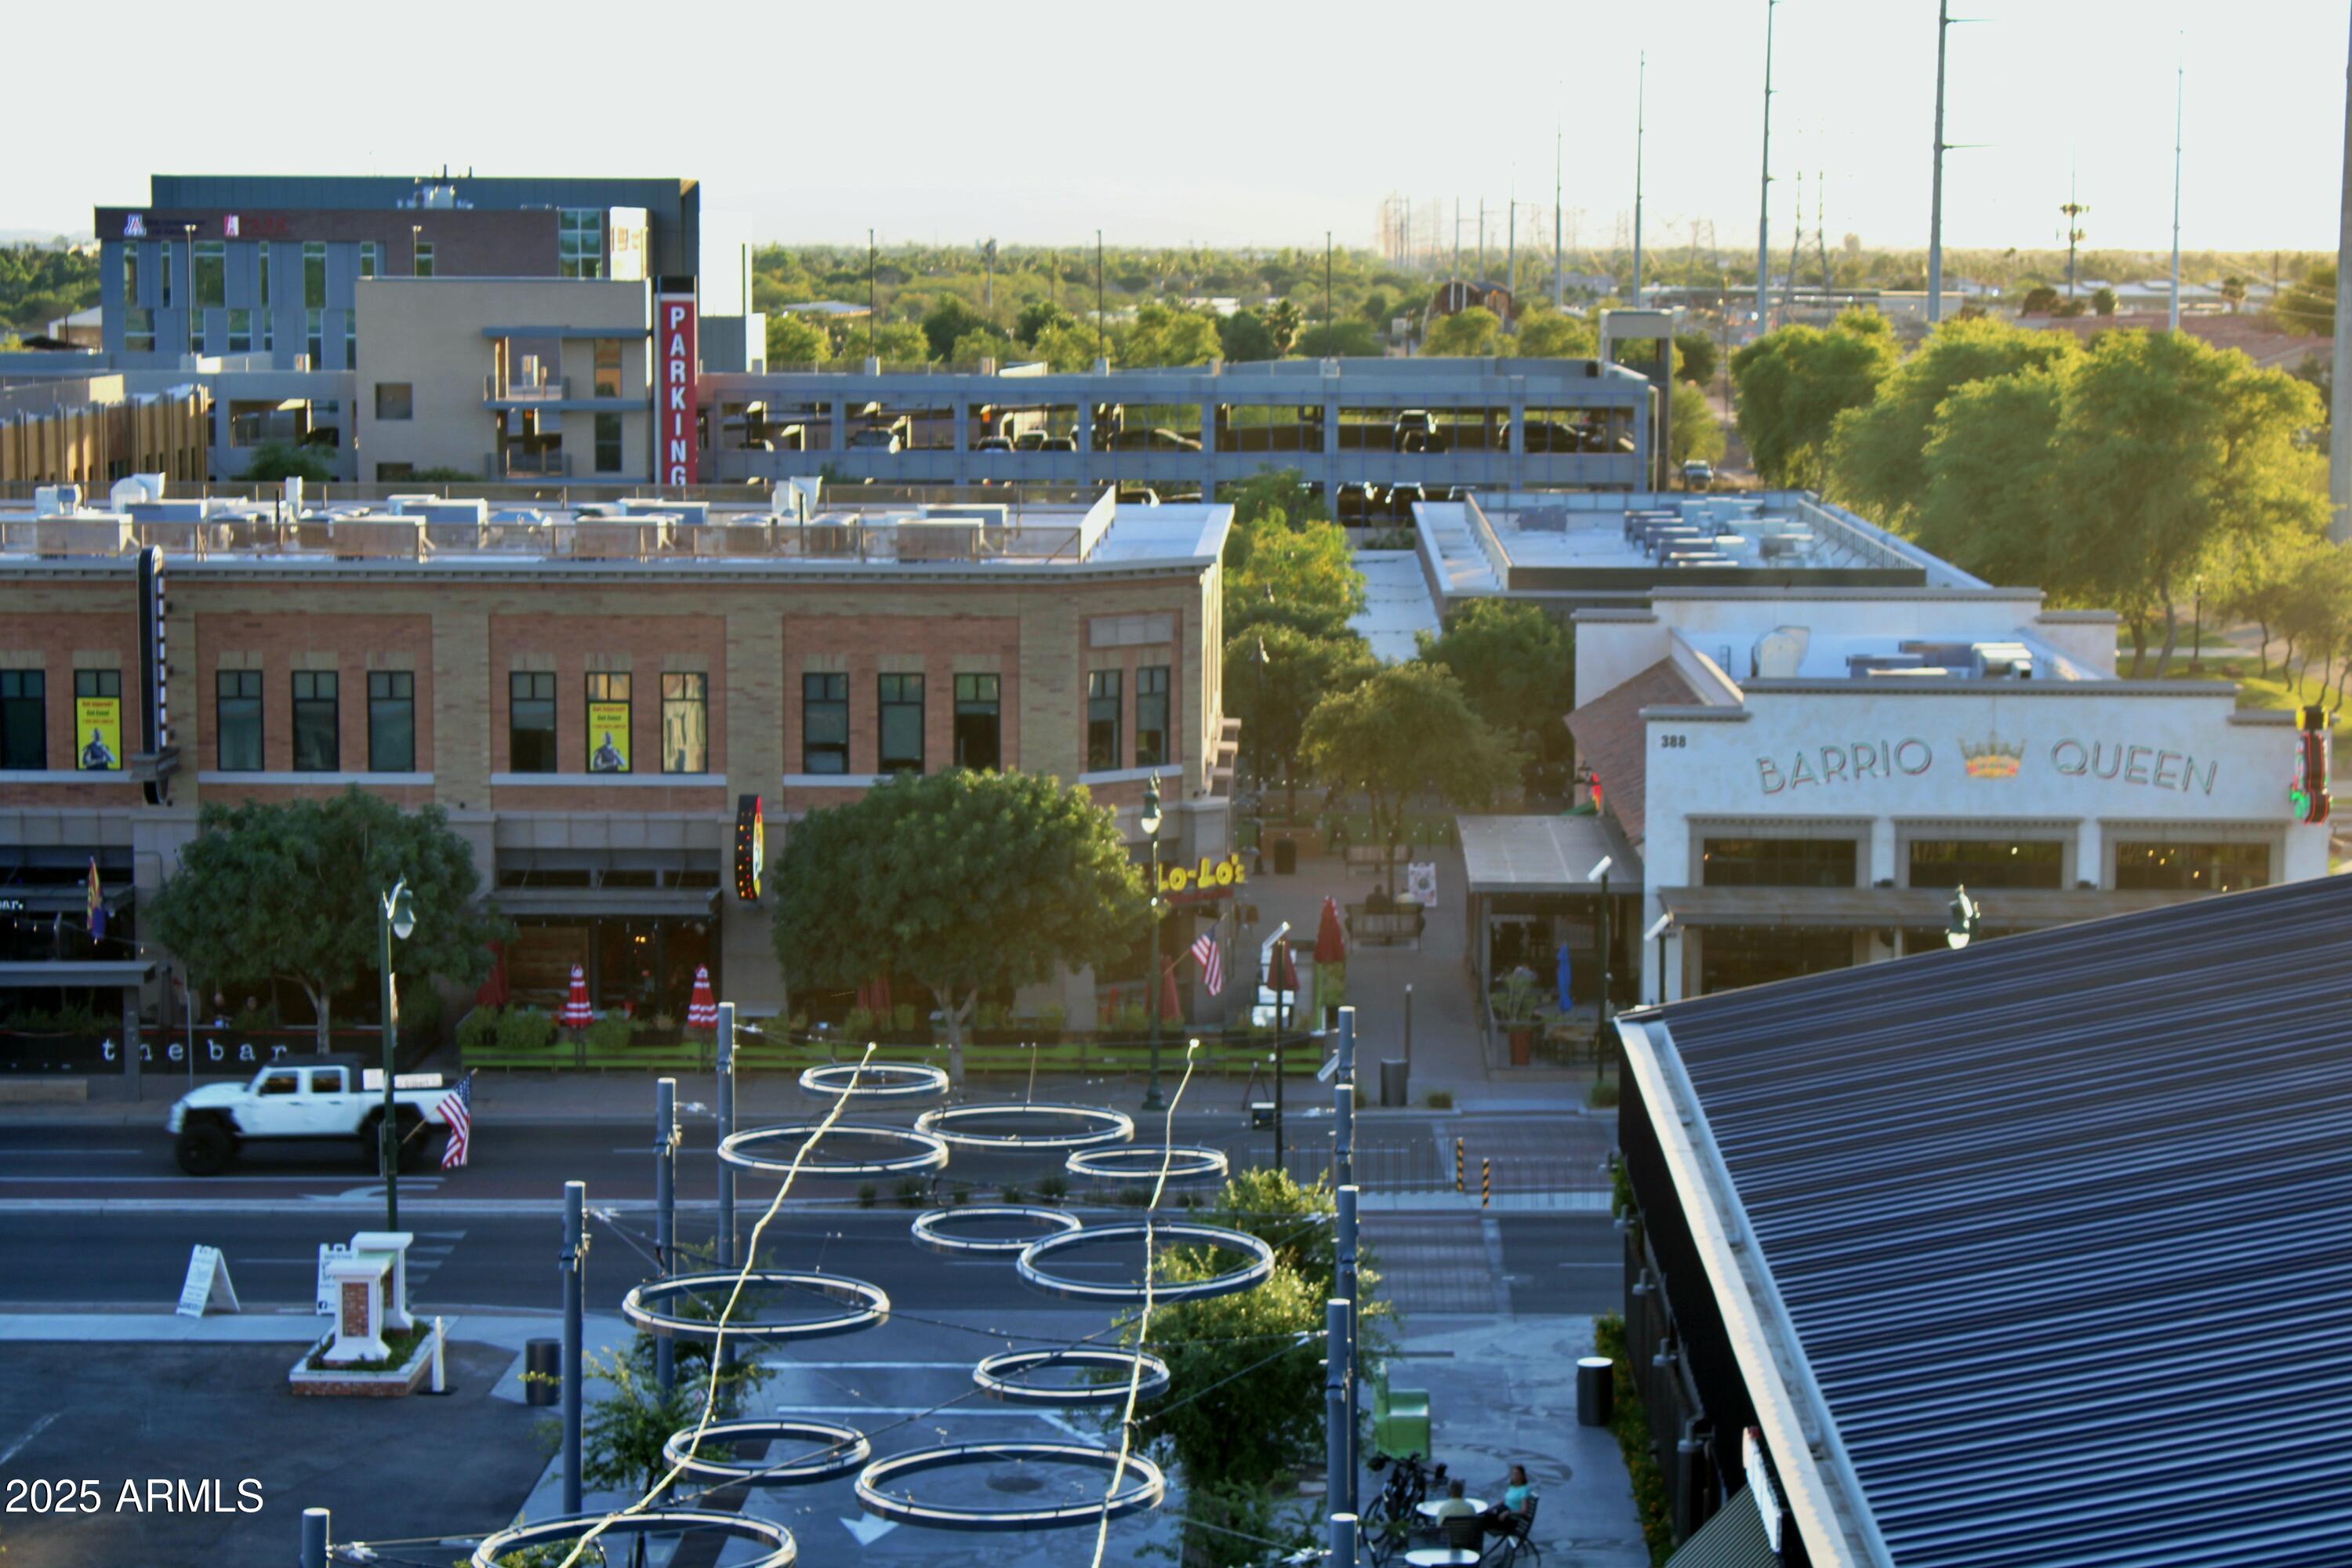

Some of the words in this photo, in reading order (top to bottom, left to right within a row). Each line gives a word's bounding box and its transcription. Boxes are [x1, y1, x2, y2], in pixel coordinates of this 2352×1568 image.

[670, 307, 686, 487] PARKING
[1661, 735, 1686, 748] 388
[1755, 736, 1933, 795] BARRIO
[2050, 738, 2218, 795] QUEEN
[207, 1038, 288, 1061] bar
